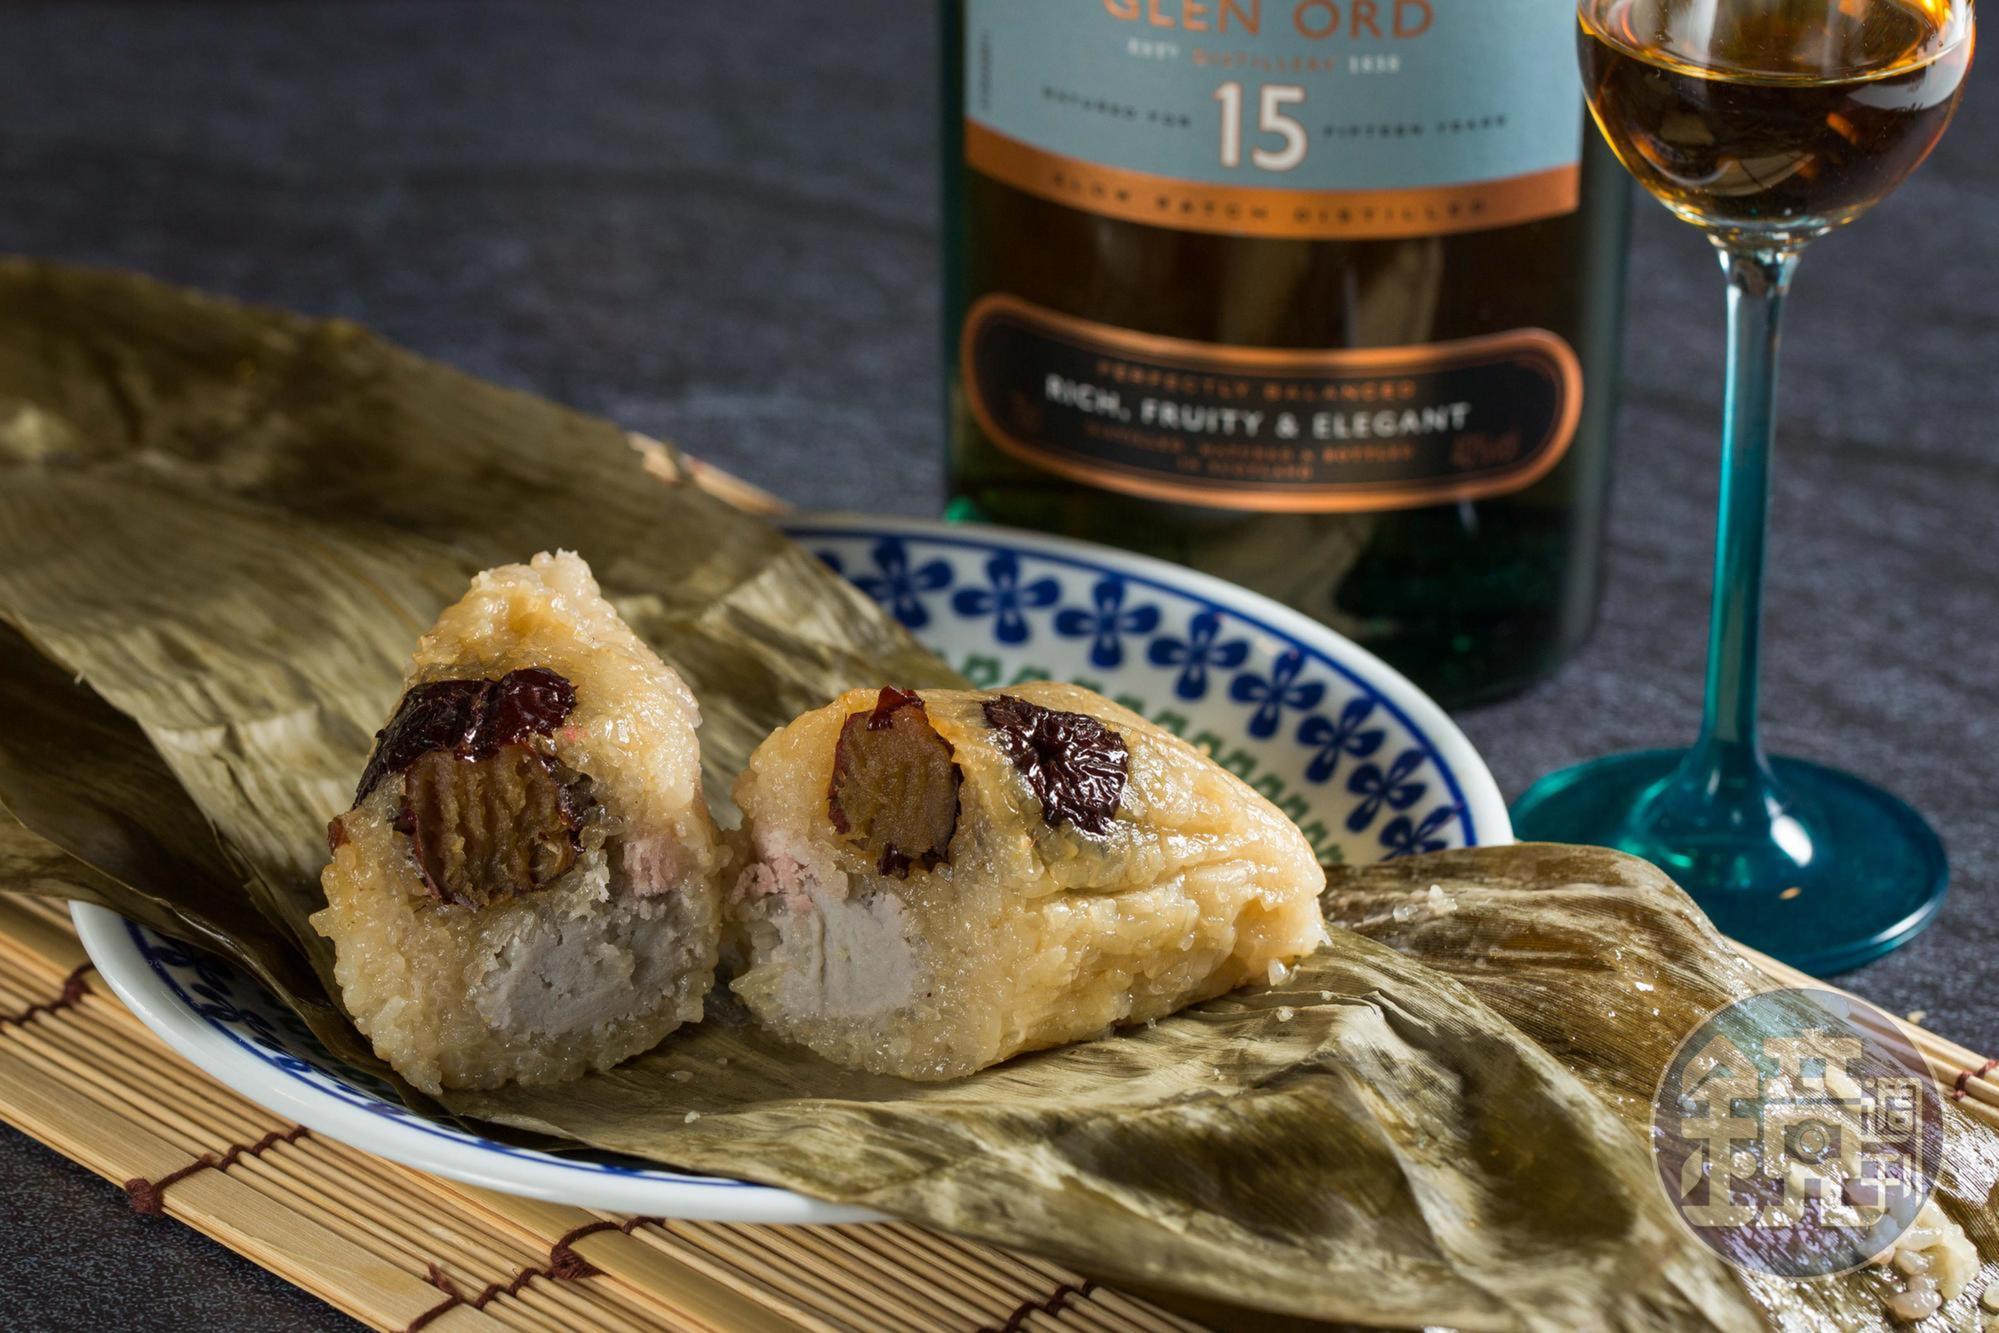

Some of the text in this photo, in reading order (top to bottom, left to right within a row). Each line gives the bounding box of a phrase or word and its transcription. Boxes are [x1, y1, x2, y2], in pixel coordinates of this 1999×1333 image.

[1292, 0, 1435, 40] ORD
[1212, 80, 1309, 172] 15
[1045, 373, 1132, 424] RICH,
[1140, 397, 1265, 438] FRUITY
[1274, 410, 1300, 440] &
[1311, 400, 1472, 440] ELEGANT
